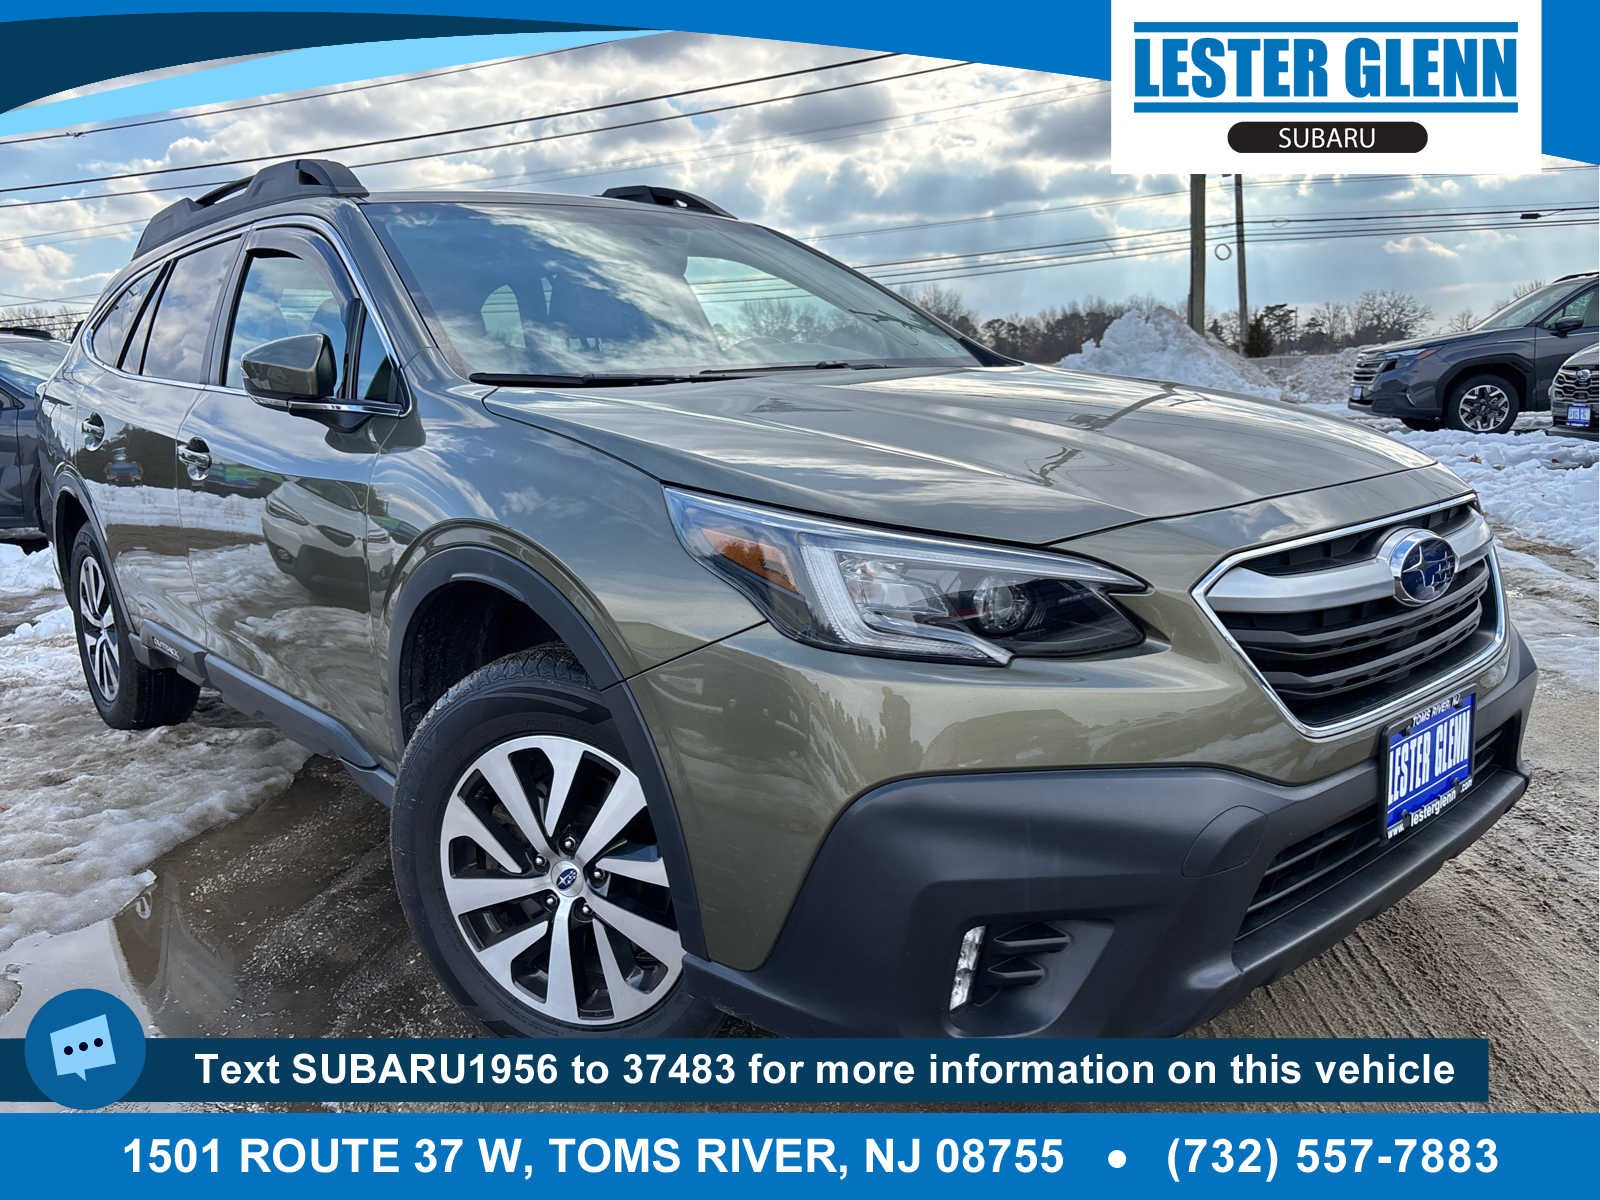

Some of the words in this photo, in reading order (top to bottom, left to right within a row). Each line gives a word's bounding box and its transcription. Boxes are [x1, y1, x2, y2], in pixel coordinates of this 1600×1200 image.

[1388, 731, 1431, 806] LESTER
[1435, 709, 1471, 777] GLENN
[1410, 789, 1456, 827] lesterglenn
